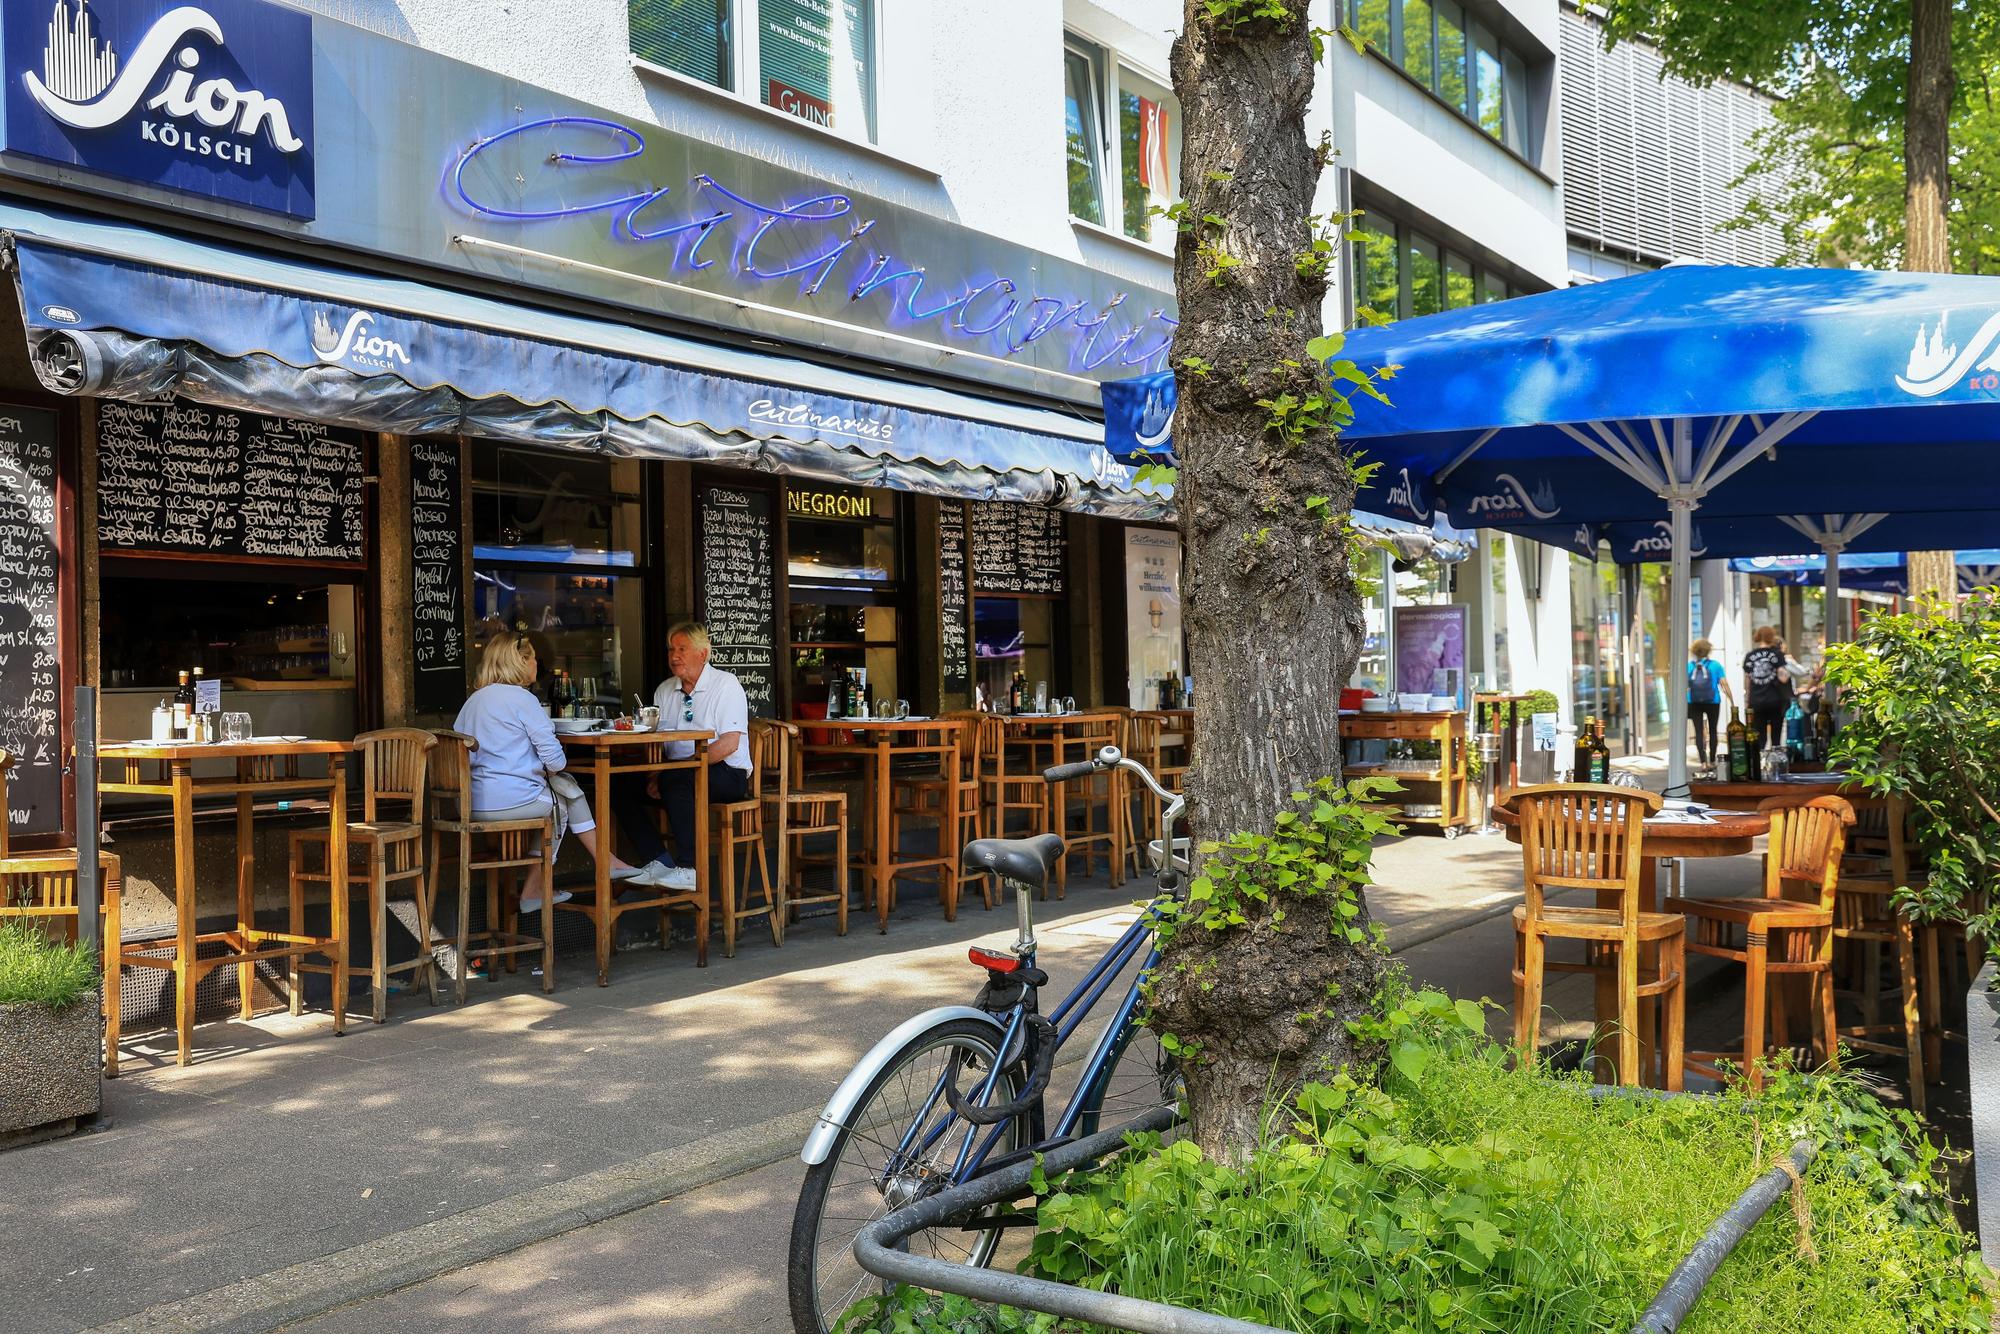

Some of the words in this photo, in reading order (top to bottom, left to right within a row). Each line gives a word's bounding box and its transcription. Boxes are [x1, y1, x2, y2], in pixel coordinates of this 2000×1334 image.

[22, 5, 304, 153] Sion
[141, 120, 253, 165] KÖLSCH
[456, 116, 1179, 371] Culinariu
[311, 311, 411, 365] Sion
[351, 354, 394, 369] KÖLSCH
[428, 462, 448, 480] des
[412, 506, 447, 524] Rosso
[788, 490, 871, 516] NEGRONI
